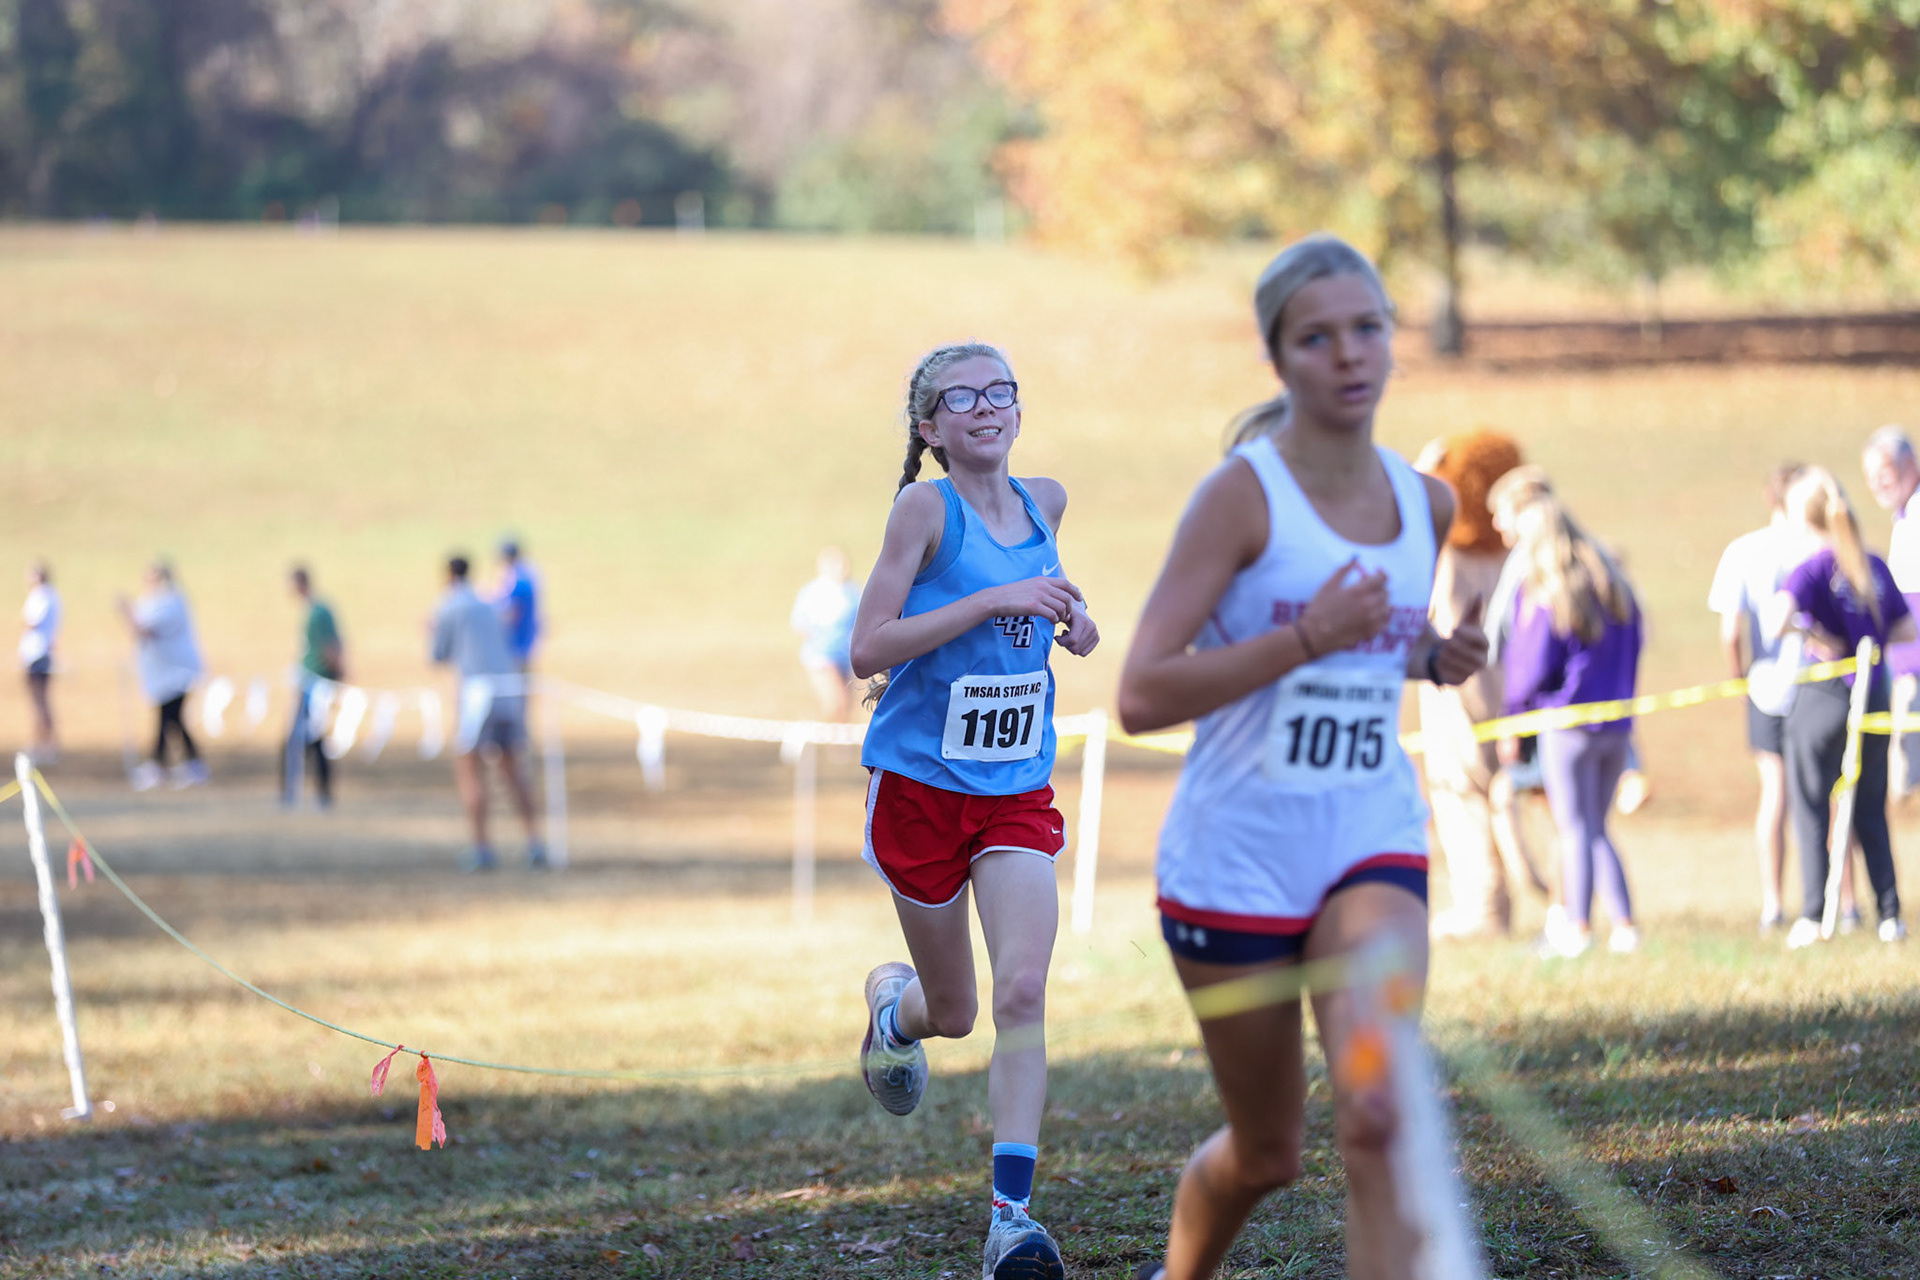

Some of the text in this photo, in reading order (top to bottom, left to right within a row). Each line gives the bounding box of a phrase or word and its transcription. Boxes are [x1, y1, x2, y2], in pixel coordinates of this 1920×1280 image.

[964, 682, 1042, 699] TMSAA STATE XC
[961, 704, 1035, 749] 1197
[1286, 713, 1385, 771] 1015
